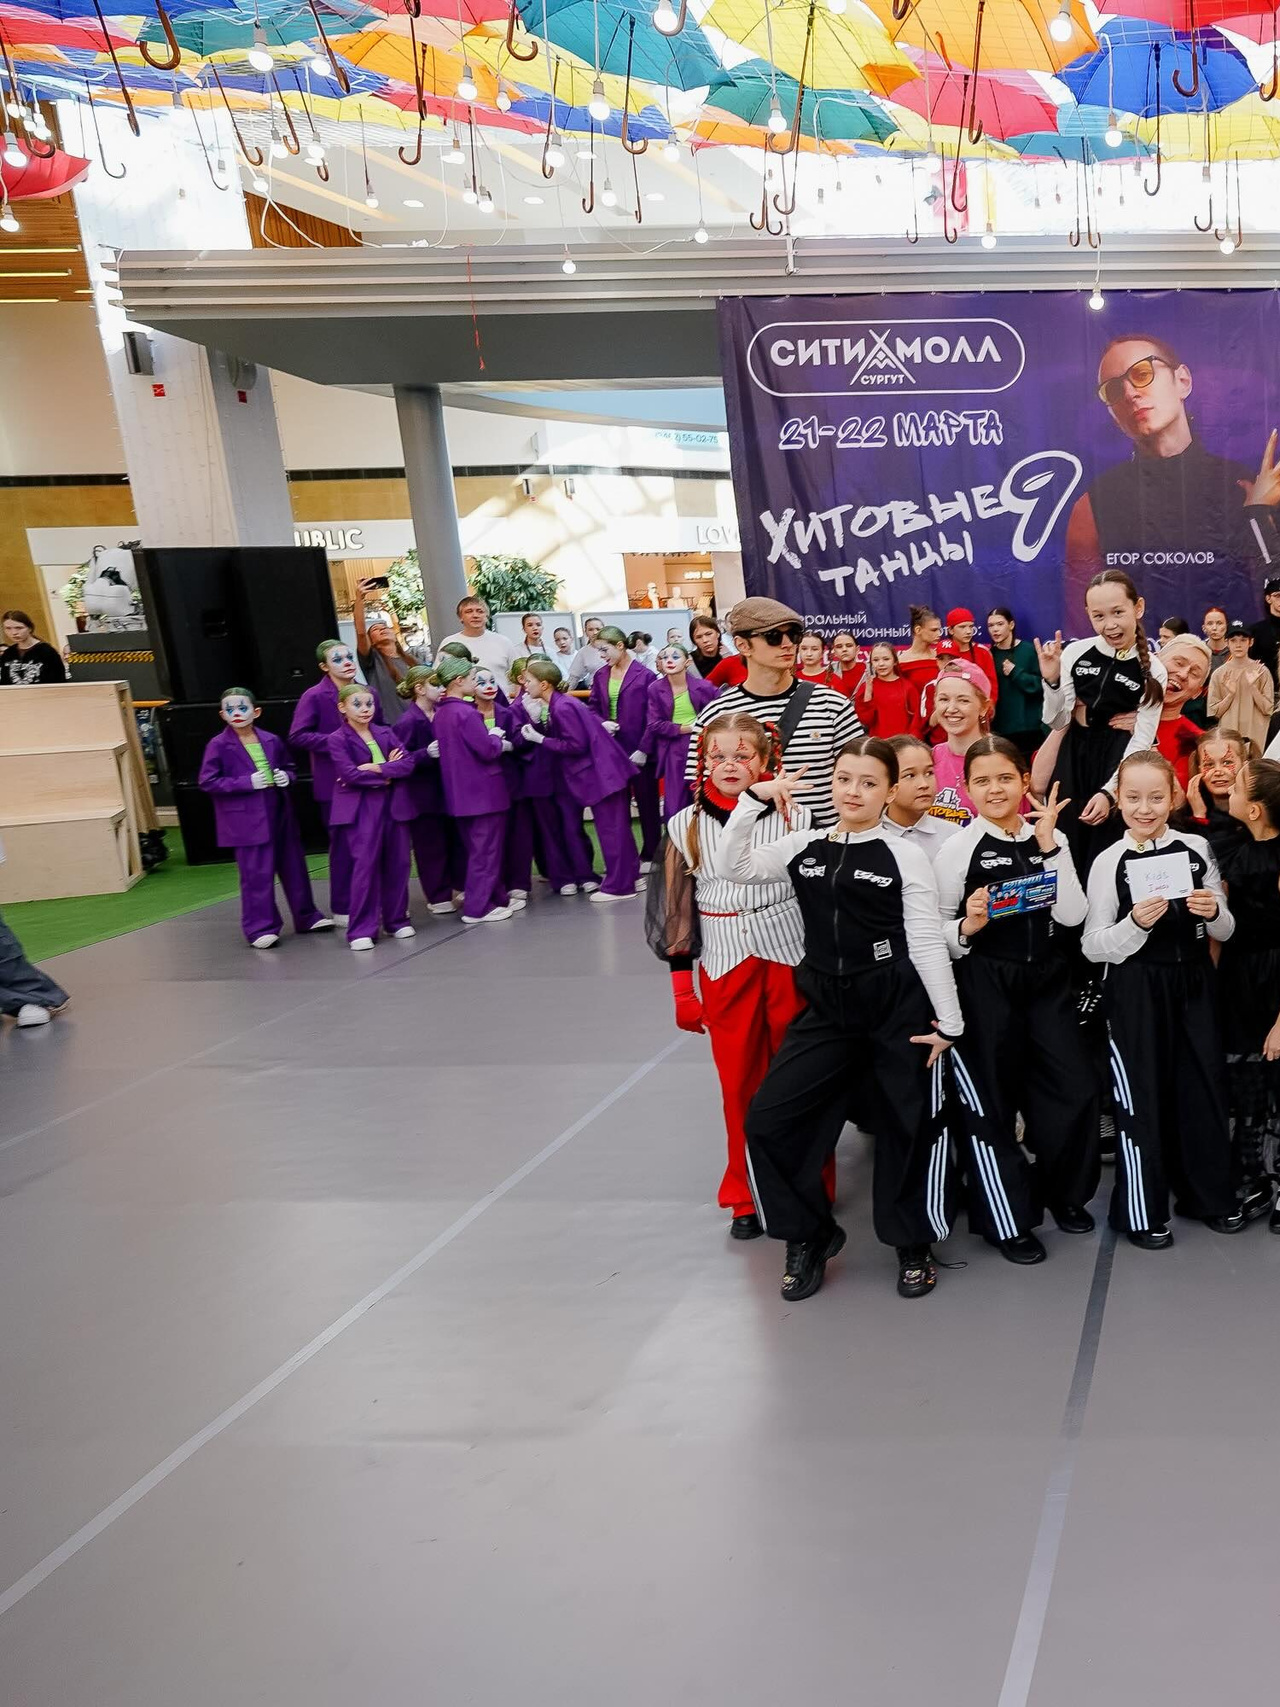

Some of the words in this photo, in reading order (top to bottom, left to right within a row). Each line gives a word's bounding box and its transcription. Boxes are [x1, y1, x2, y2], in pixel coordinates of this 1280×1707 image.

[770, 338, 865, 366] СИТИ
[896, 336, 1002, 364] МОЛЛ
[860, 374, 905, 385] СУРГУТ
[778, 416, 888, 450] 21-22
[893, 410, 1003, 447] МАРТА
[818, 531, 974, 597] ТАНЦЫ
[1106, 552, 1140, 565] ЕГОР
[1142, 551, 1215, 565] СОКОЛОВ
